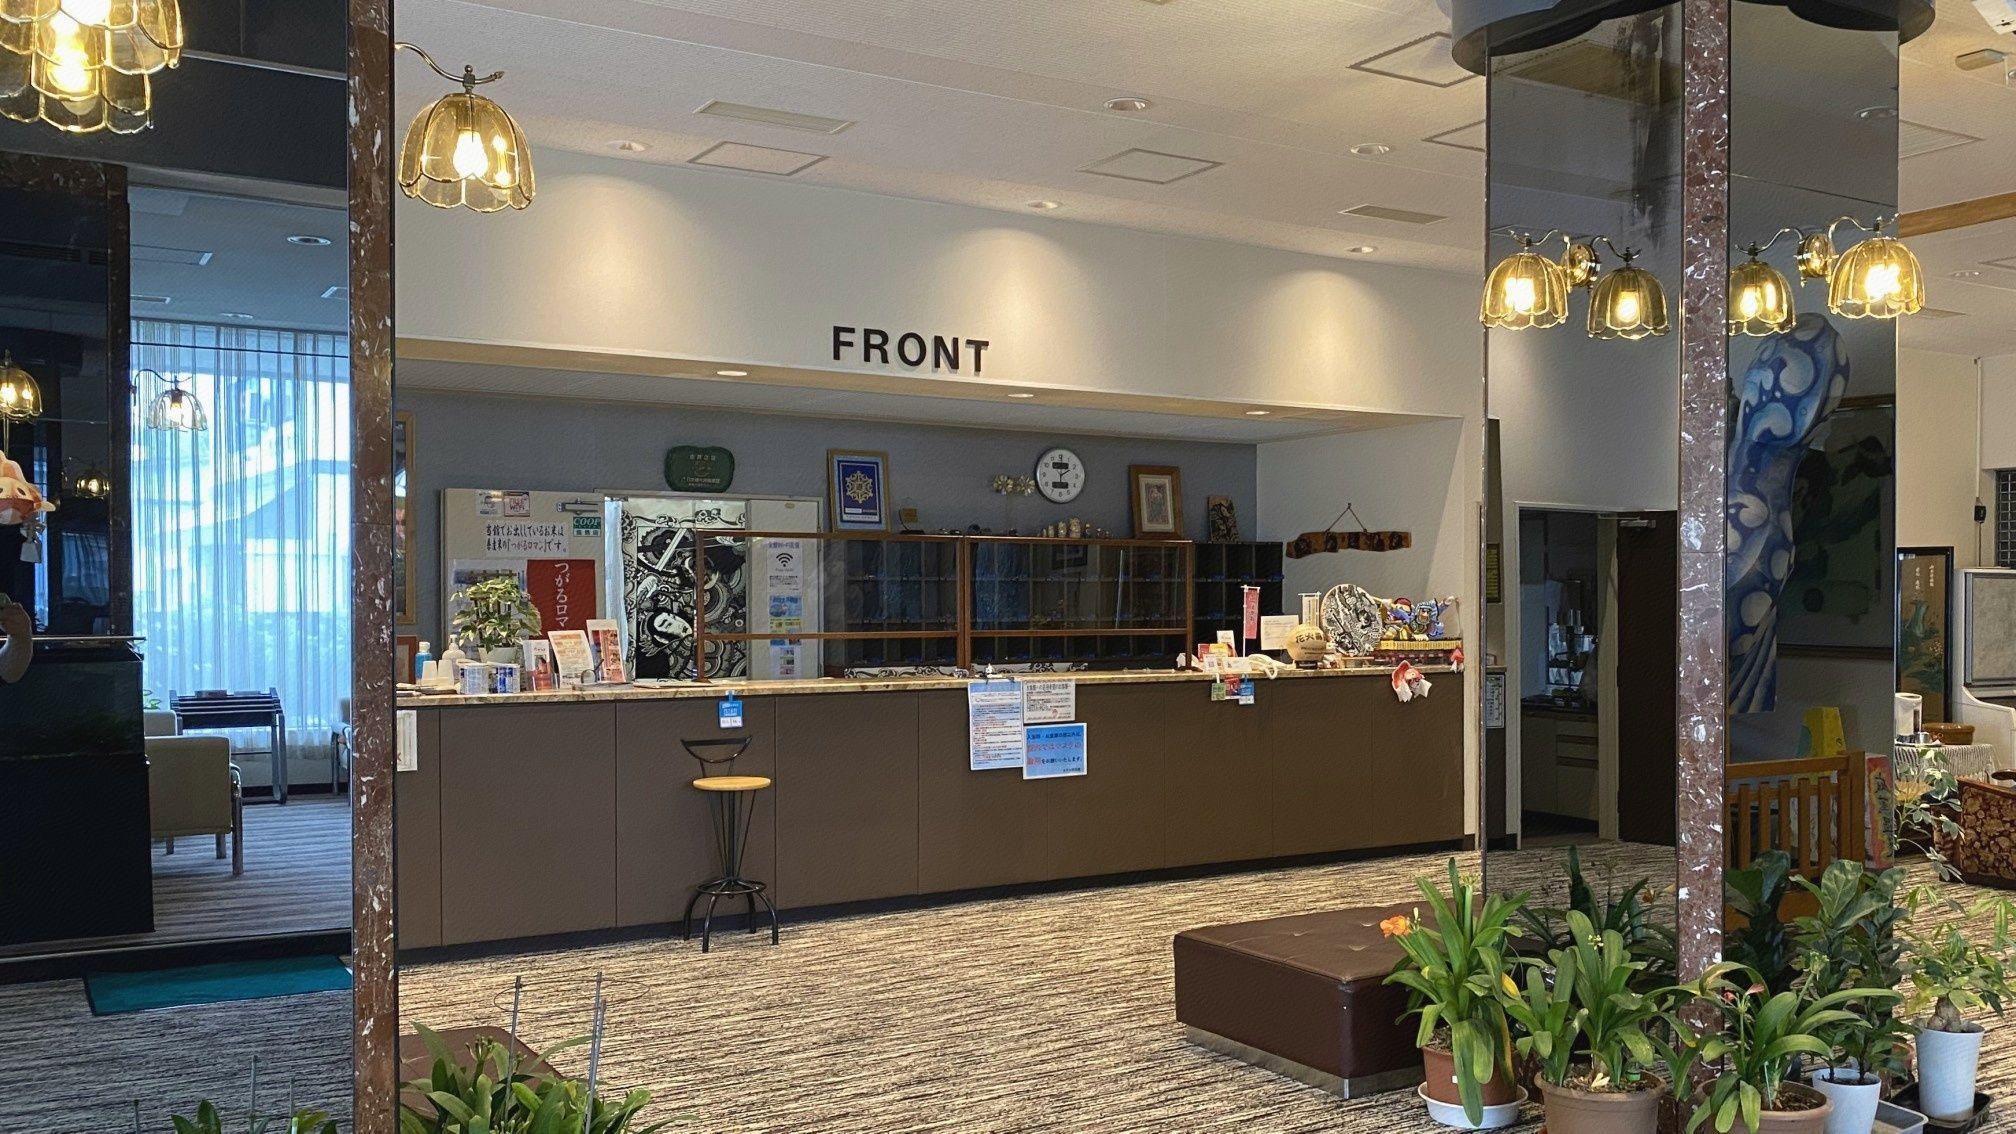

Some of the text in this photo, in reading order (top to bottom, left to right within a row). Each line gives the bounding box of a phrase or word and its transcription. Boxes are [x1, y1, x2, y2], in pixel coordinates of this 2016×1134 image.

[832, 325, 990, 373] FRONT
[574, 517, 601, 525] COOP
[554, 562, 571, 629] つがるロマ
